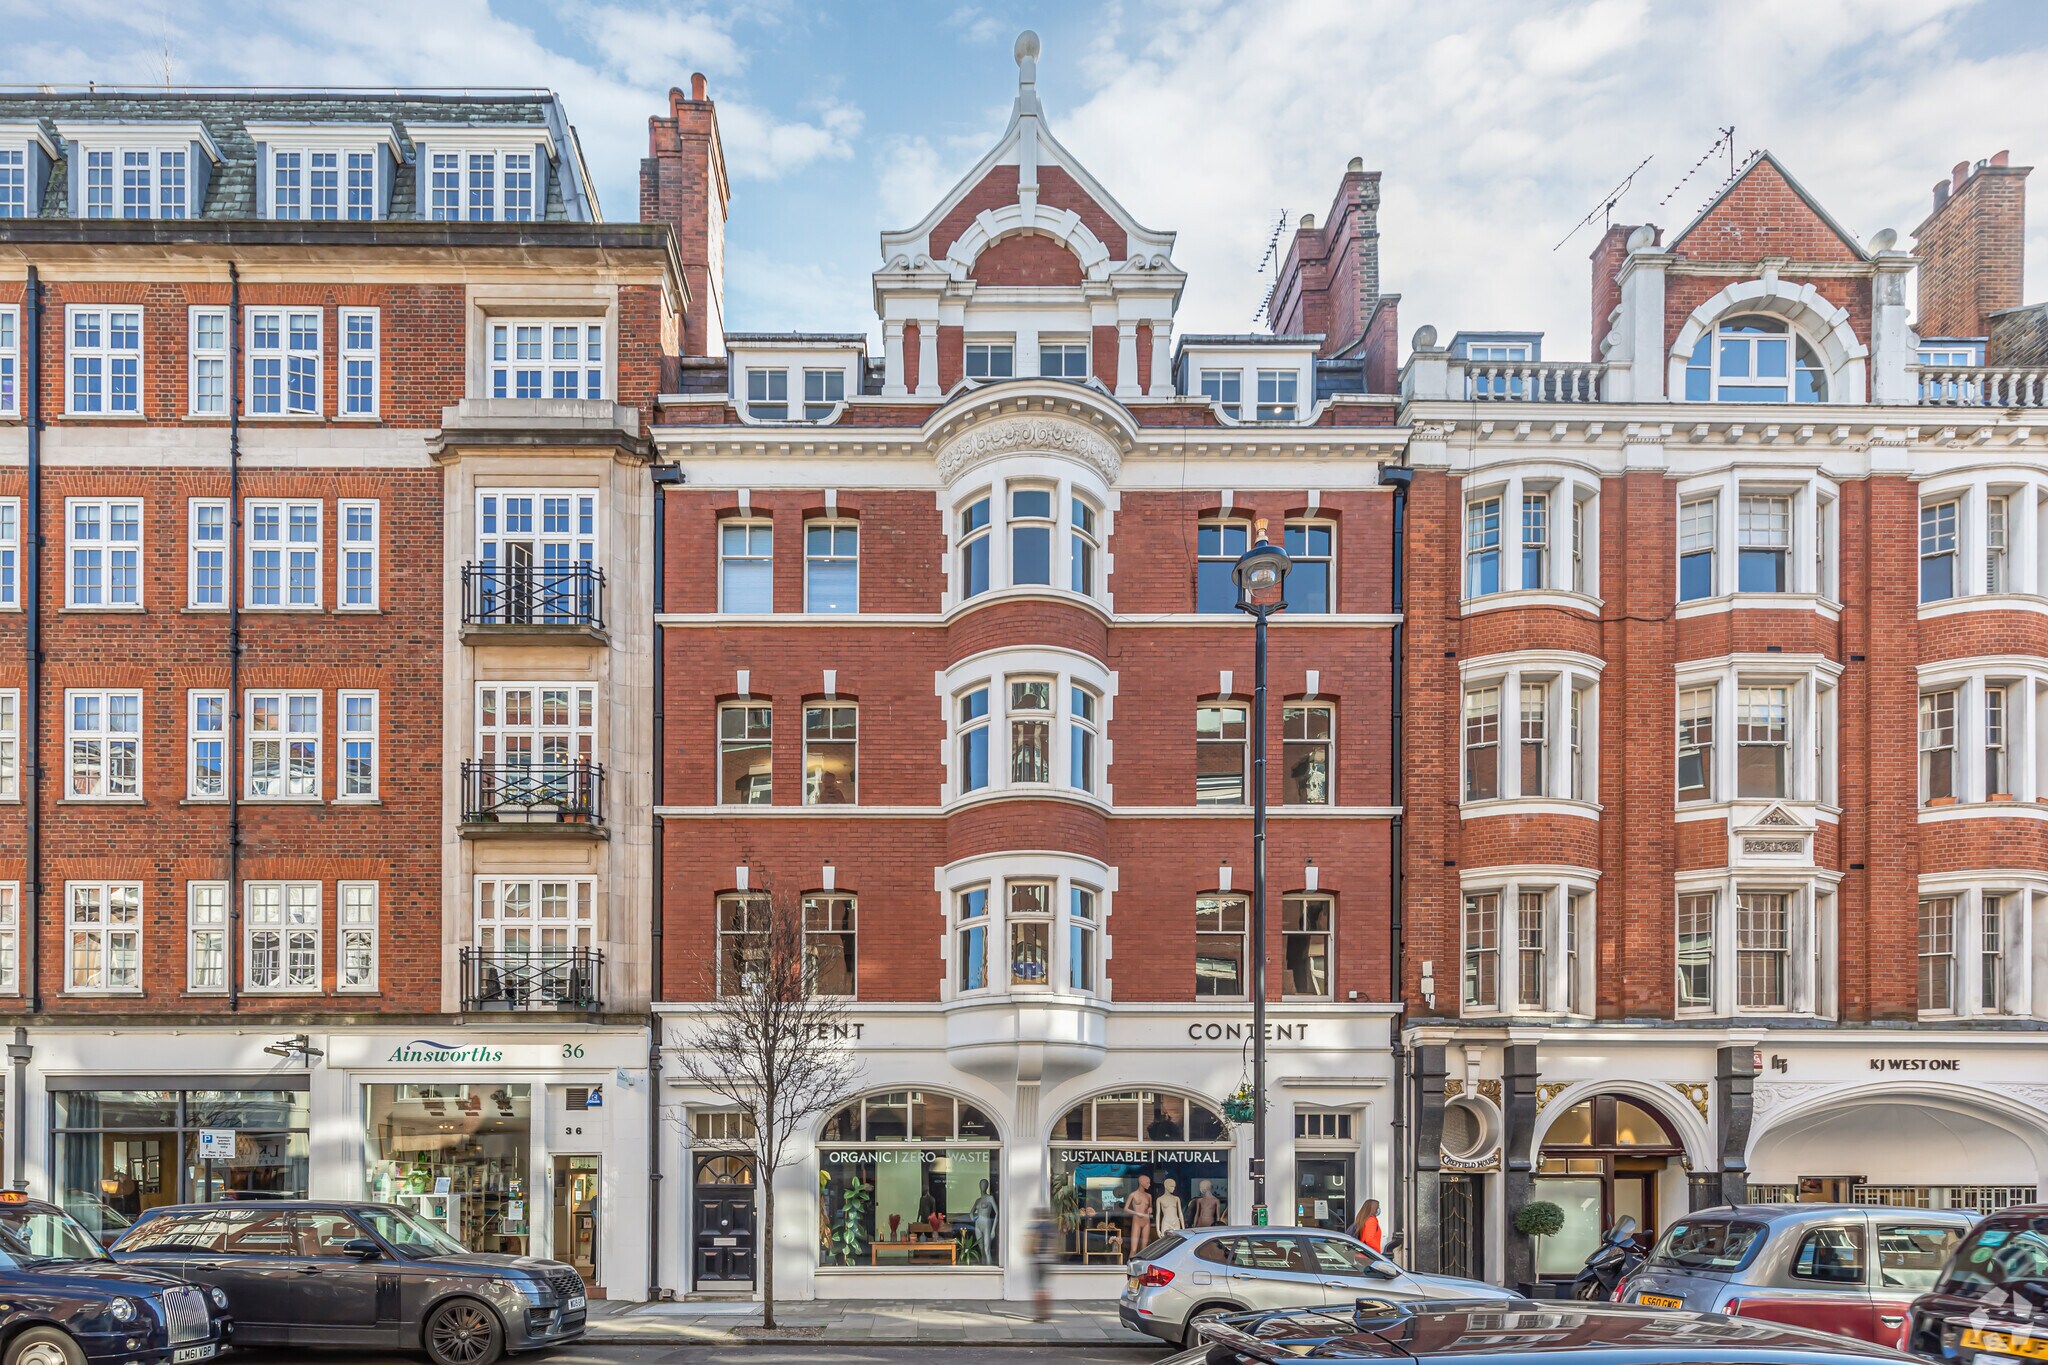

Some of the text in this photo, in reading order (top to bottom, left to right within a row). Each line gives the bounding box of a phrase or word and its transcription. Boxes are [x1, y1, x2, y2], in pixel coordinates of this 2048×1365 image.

[1188, 1023, 1309, 1040] CONTENT
[387, 1046, 503, 1062] Ainsworths
[562, 1043, 585, 1059] 36
[1870, 1059, 1961, 1071] KJ WEST ONE
[829, 1151, 989, 1163] ORGANIC ZERO WASTE
[1061, 1151, 1220, 1163] SUSTAINABLE NATURAL
[1477, 1154, 1498, 1168] HOUSE
